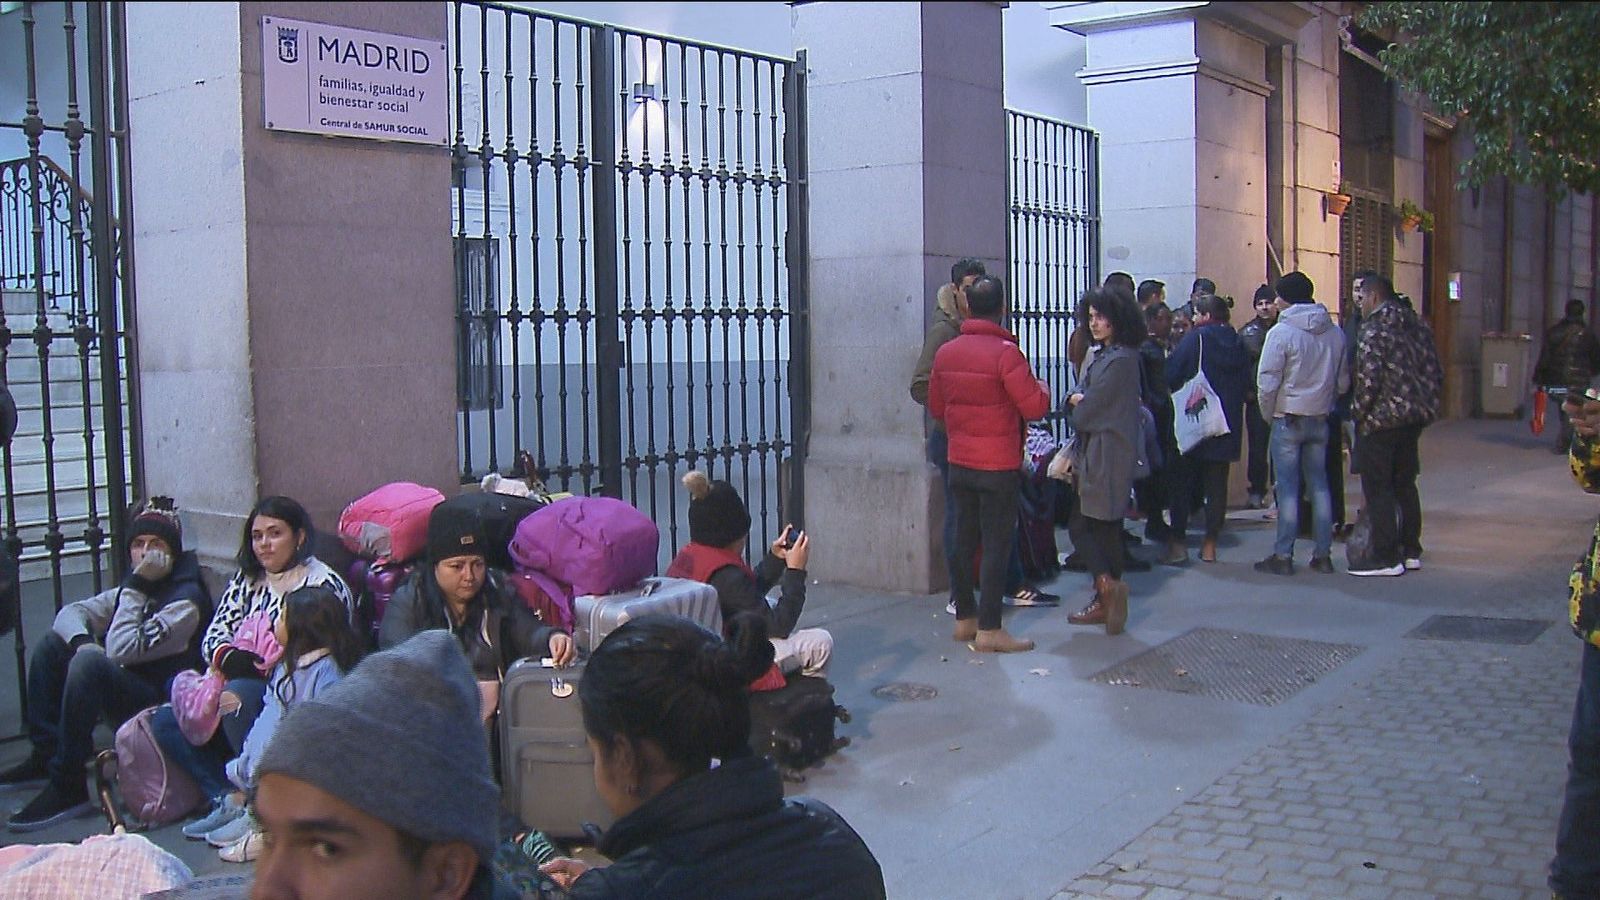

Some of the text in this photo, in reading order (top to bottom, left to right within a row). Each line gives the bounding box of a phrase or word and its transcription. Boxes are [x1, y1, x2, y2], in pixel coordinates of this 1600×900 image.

[318, 36, 430, 74] MADRID
[319, 75, 425, 102] familias, igualdad y
[319, 92, 409, 113] bienestar social
[320, 117, 428, 136] Central de SAMUR SOCIAL
